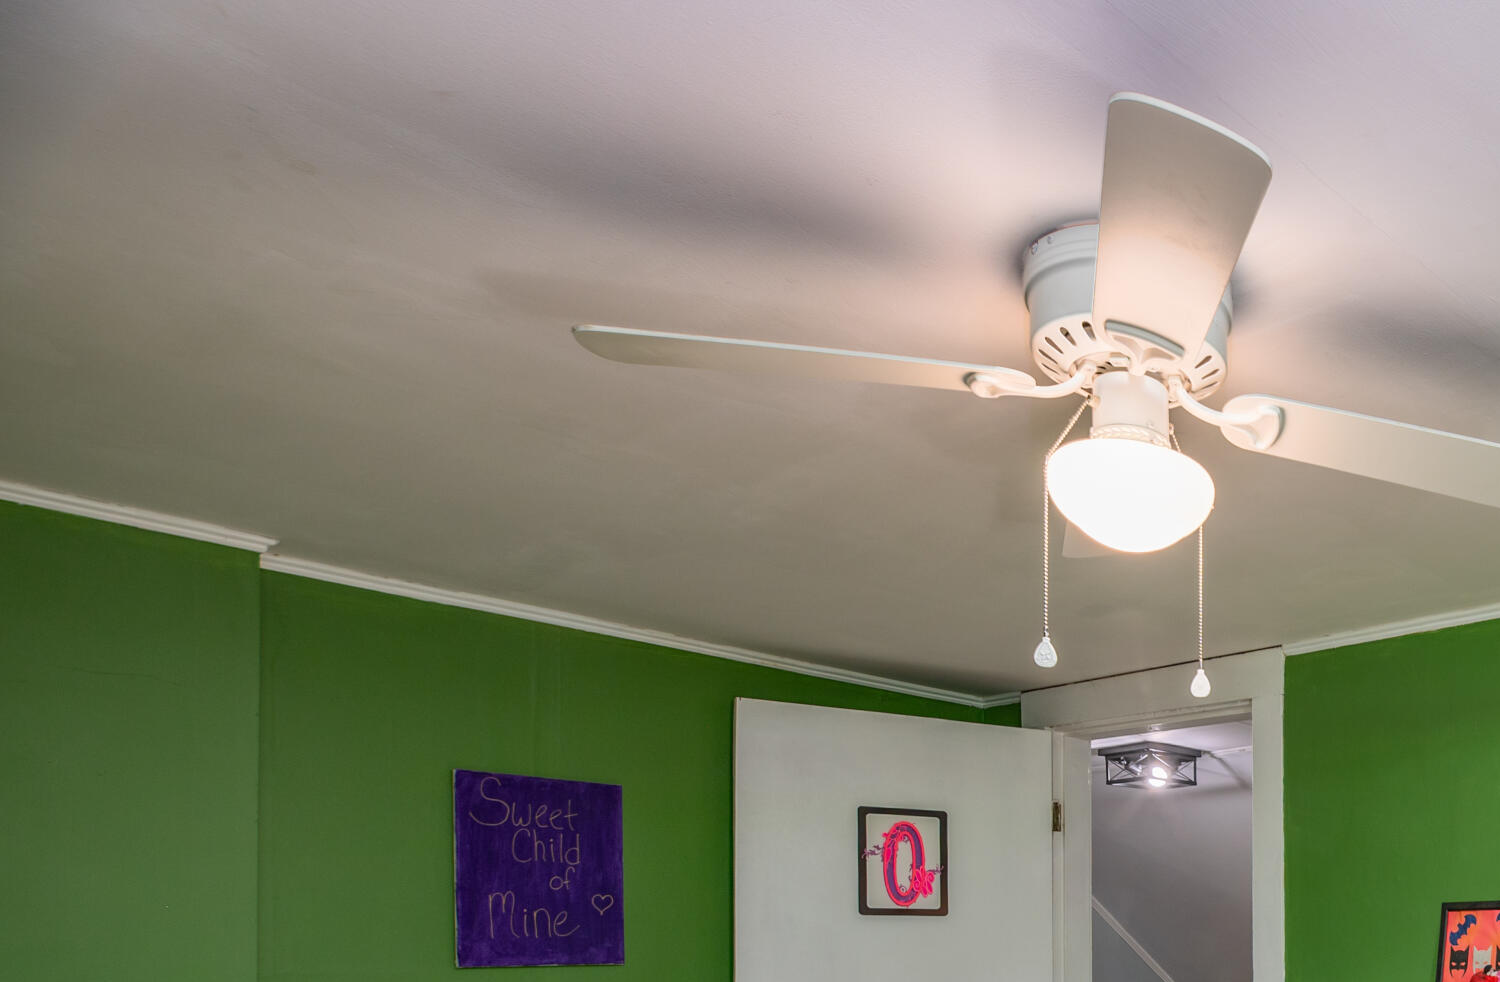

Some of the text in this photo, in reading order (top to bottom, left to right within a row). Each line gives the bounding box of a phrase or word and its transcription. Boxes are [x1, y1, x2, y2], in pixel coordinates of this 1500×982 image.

[469, 776, 579, 831] Sweet
[511, 828, 581, 865] Child
[549, 866, 576, 891] of
[488, 890, 581, 938] Mine
